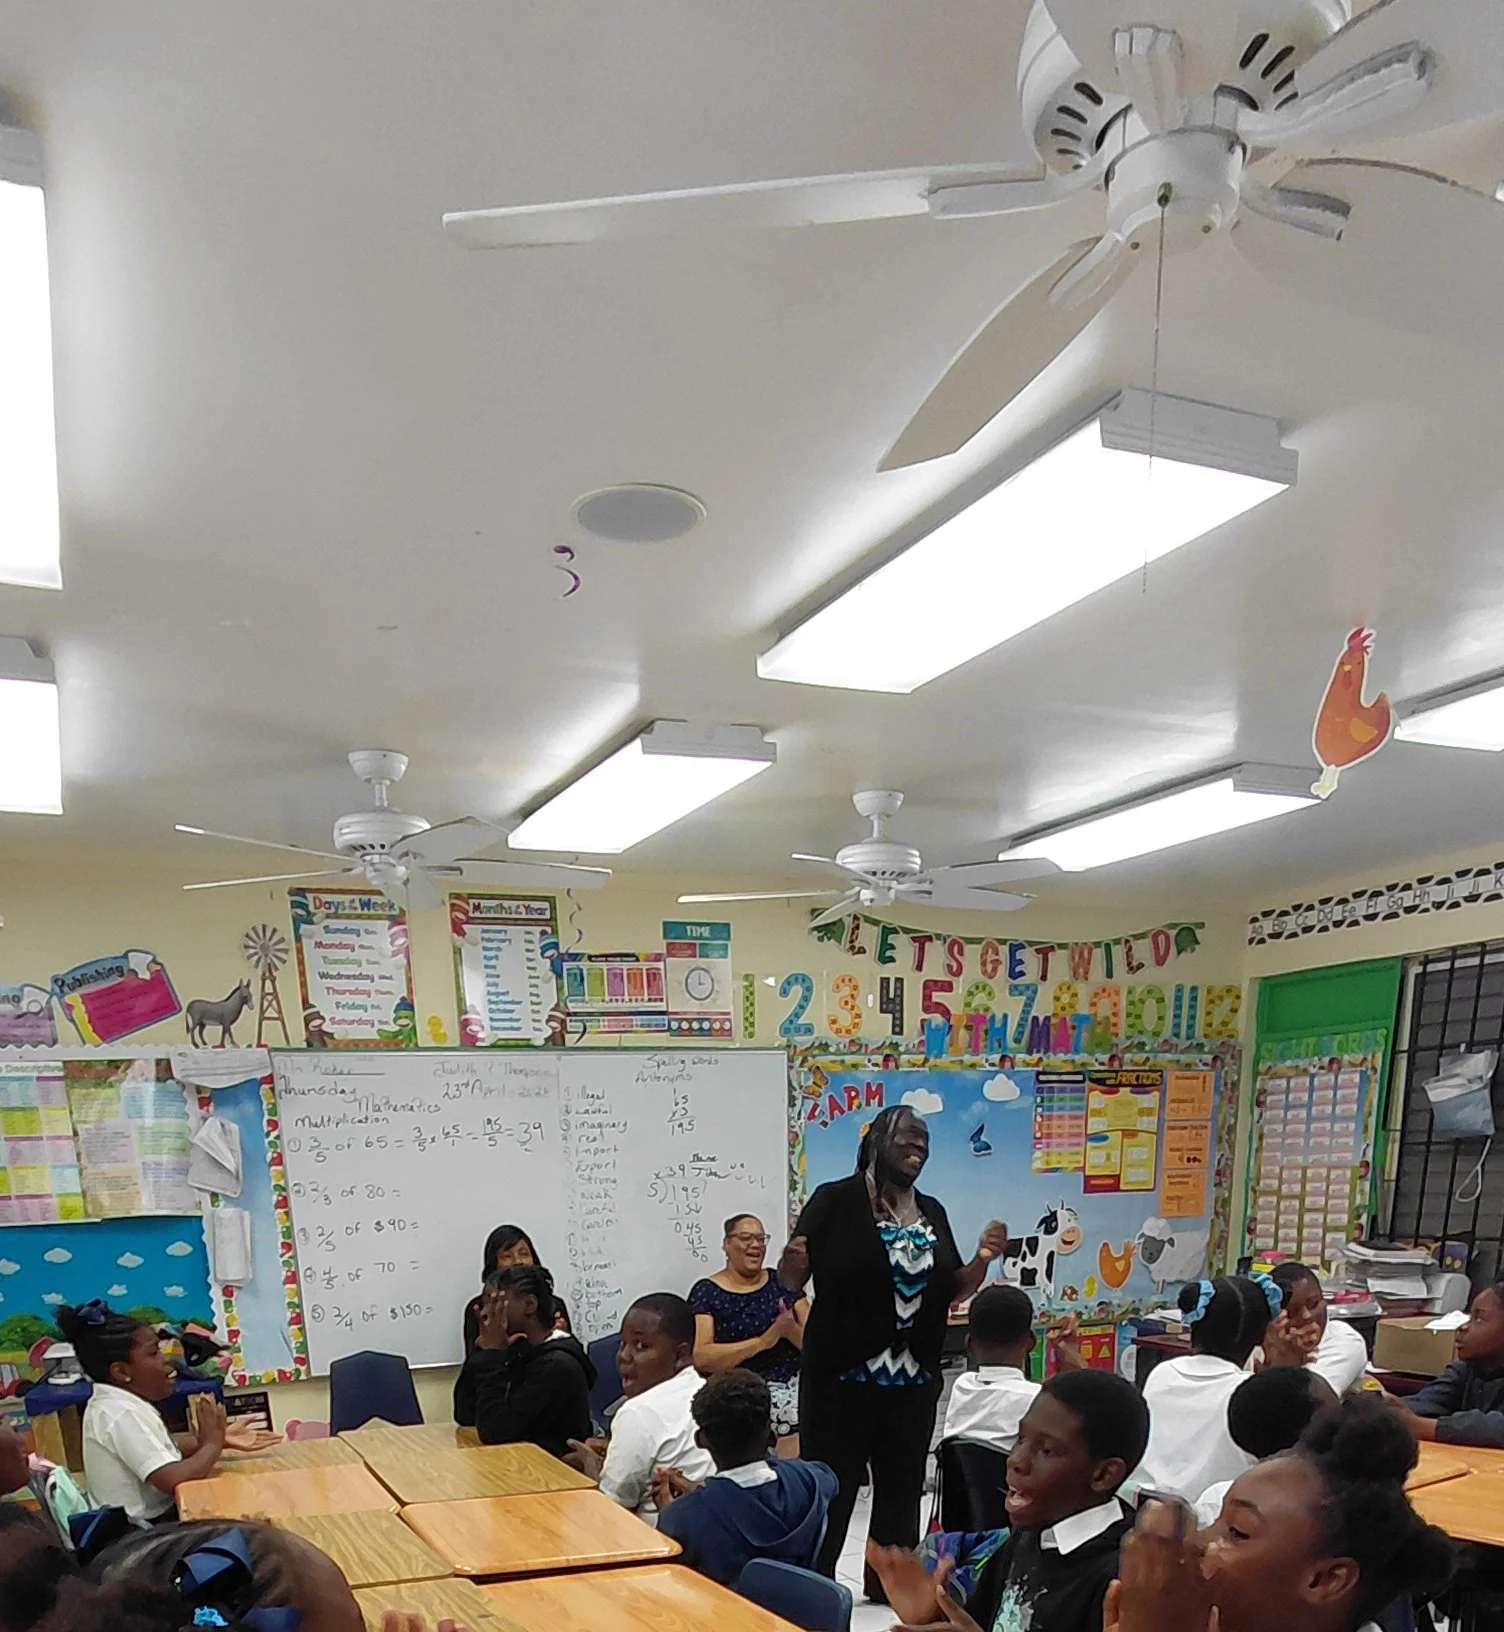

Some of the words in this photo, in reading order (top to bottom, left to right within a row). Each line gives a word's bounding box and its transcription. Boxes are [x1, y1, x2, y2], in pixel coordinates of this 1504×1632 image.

[313, 896, 346, 912] Days
[359, 896, 397, 911] Week
[472, 903, 513, 915] Months
[523, 903, 548, 916] Year
[323, 925, 360, 937] Sunday
[685, 925, 711, 938] TIME
[314, 941, 356, 952] Monday
[321, 956, 362, 967] Tuesday
[979, 939, 1056, 983] GET
[1069, 928, 1172, 983] WILD
[54, 965, 125, 993] Publishing
[318, 971, 375, 983] Wednesday
[325, 986, 371, 997] Thursday
[335, 1001, 368, 1012] Friday
[779, 972, 815, 1037] 2
[827, 974, 863, 1037] 3
[879, 976, 904, 1035] 4
[919, 979, 954, 1036] 5
[1008, 982, 1040, 1045] 7
[1126, 983, 1166, 1038] 10
[1173, 983, 1198, 1040] 11
[1204, 983, 1242, 1039] 12
[329, 1017, 375, 1028] Saturday
[924, 1012, 1009, 1059] WITH
[471, 1078, 506, 1098] April
[335, 1136, 356, 1151] of
[364, 1135, 388, 1149] 65
[340, 1185, 357, 1198] of
[364, 1183, 386, 1200] 80
[344, 1220, 362, 1236] of
[347, 1267, 364, 1283] of
[373, 1260, 397, 1274] 70
[361, 1302, 379, 1323] of
